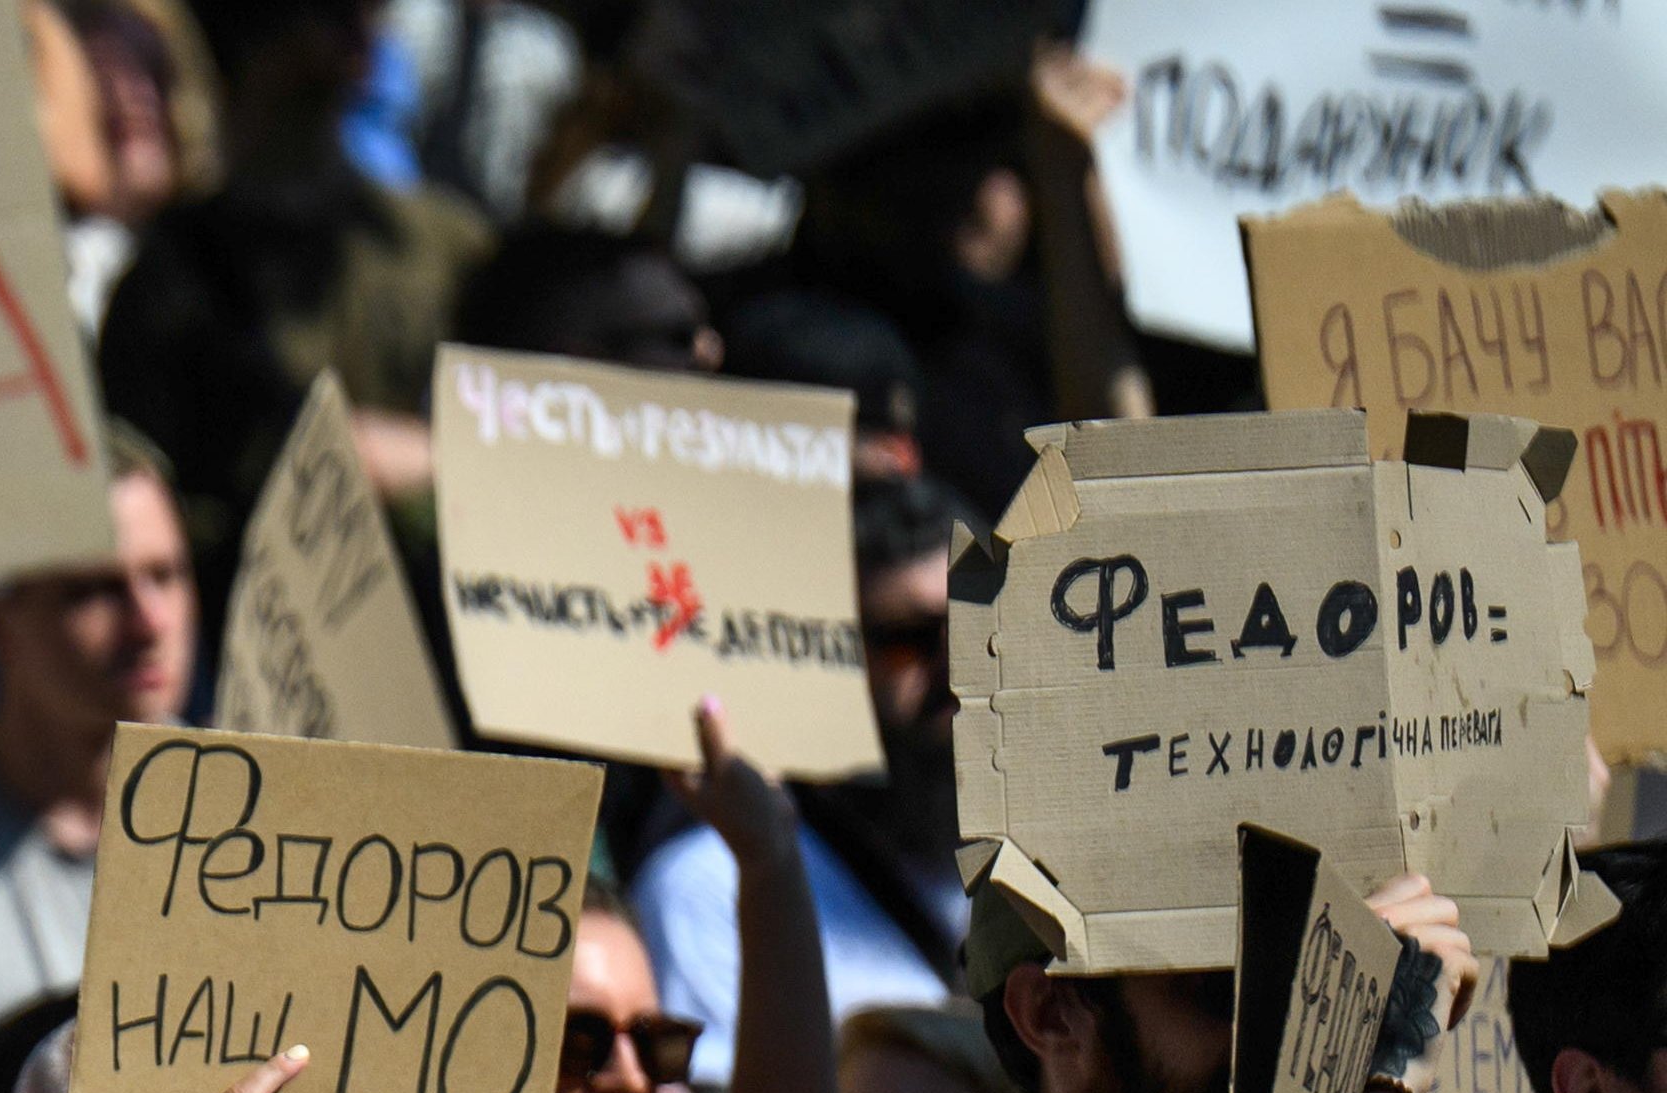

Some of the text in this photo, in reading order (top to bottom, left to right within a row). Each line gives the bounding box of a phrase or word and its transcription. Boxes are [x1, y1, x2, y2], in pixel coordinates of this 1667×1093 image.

[1317, 266, 1667, 410] Я БАЧУ ВА
[1049, 552, 1509, 672] ФЕДОРОВ=
[1439, 706, 1503, 752] ПЕРЕВАГА
[110, 972, 293, 1072] НАШ
